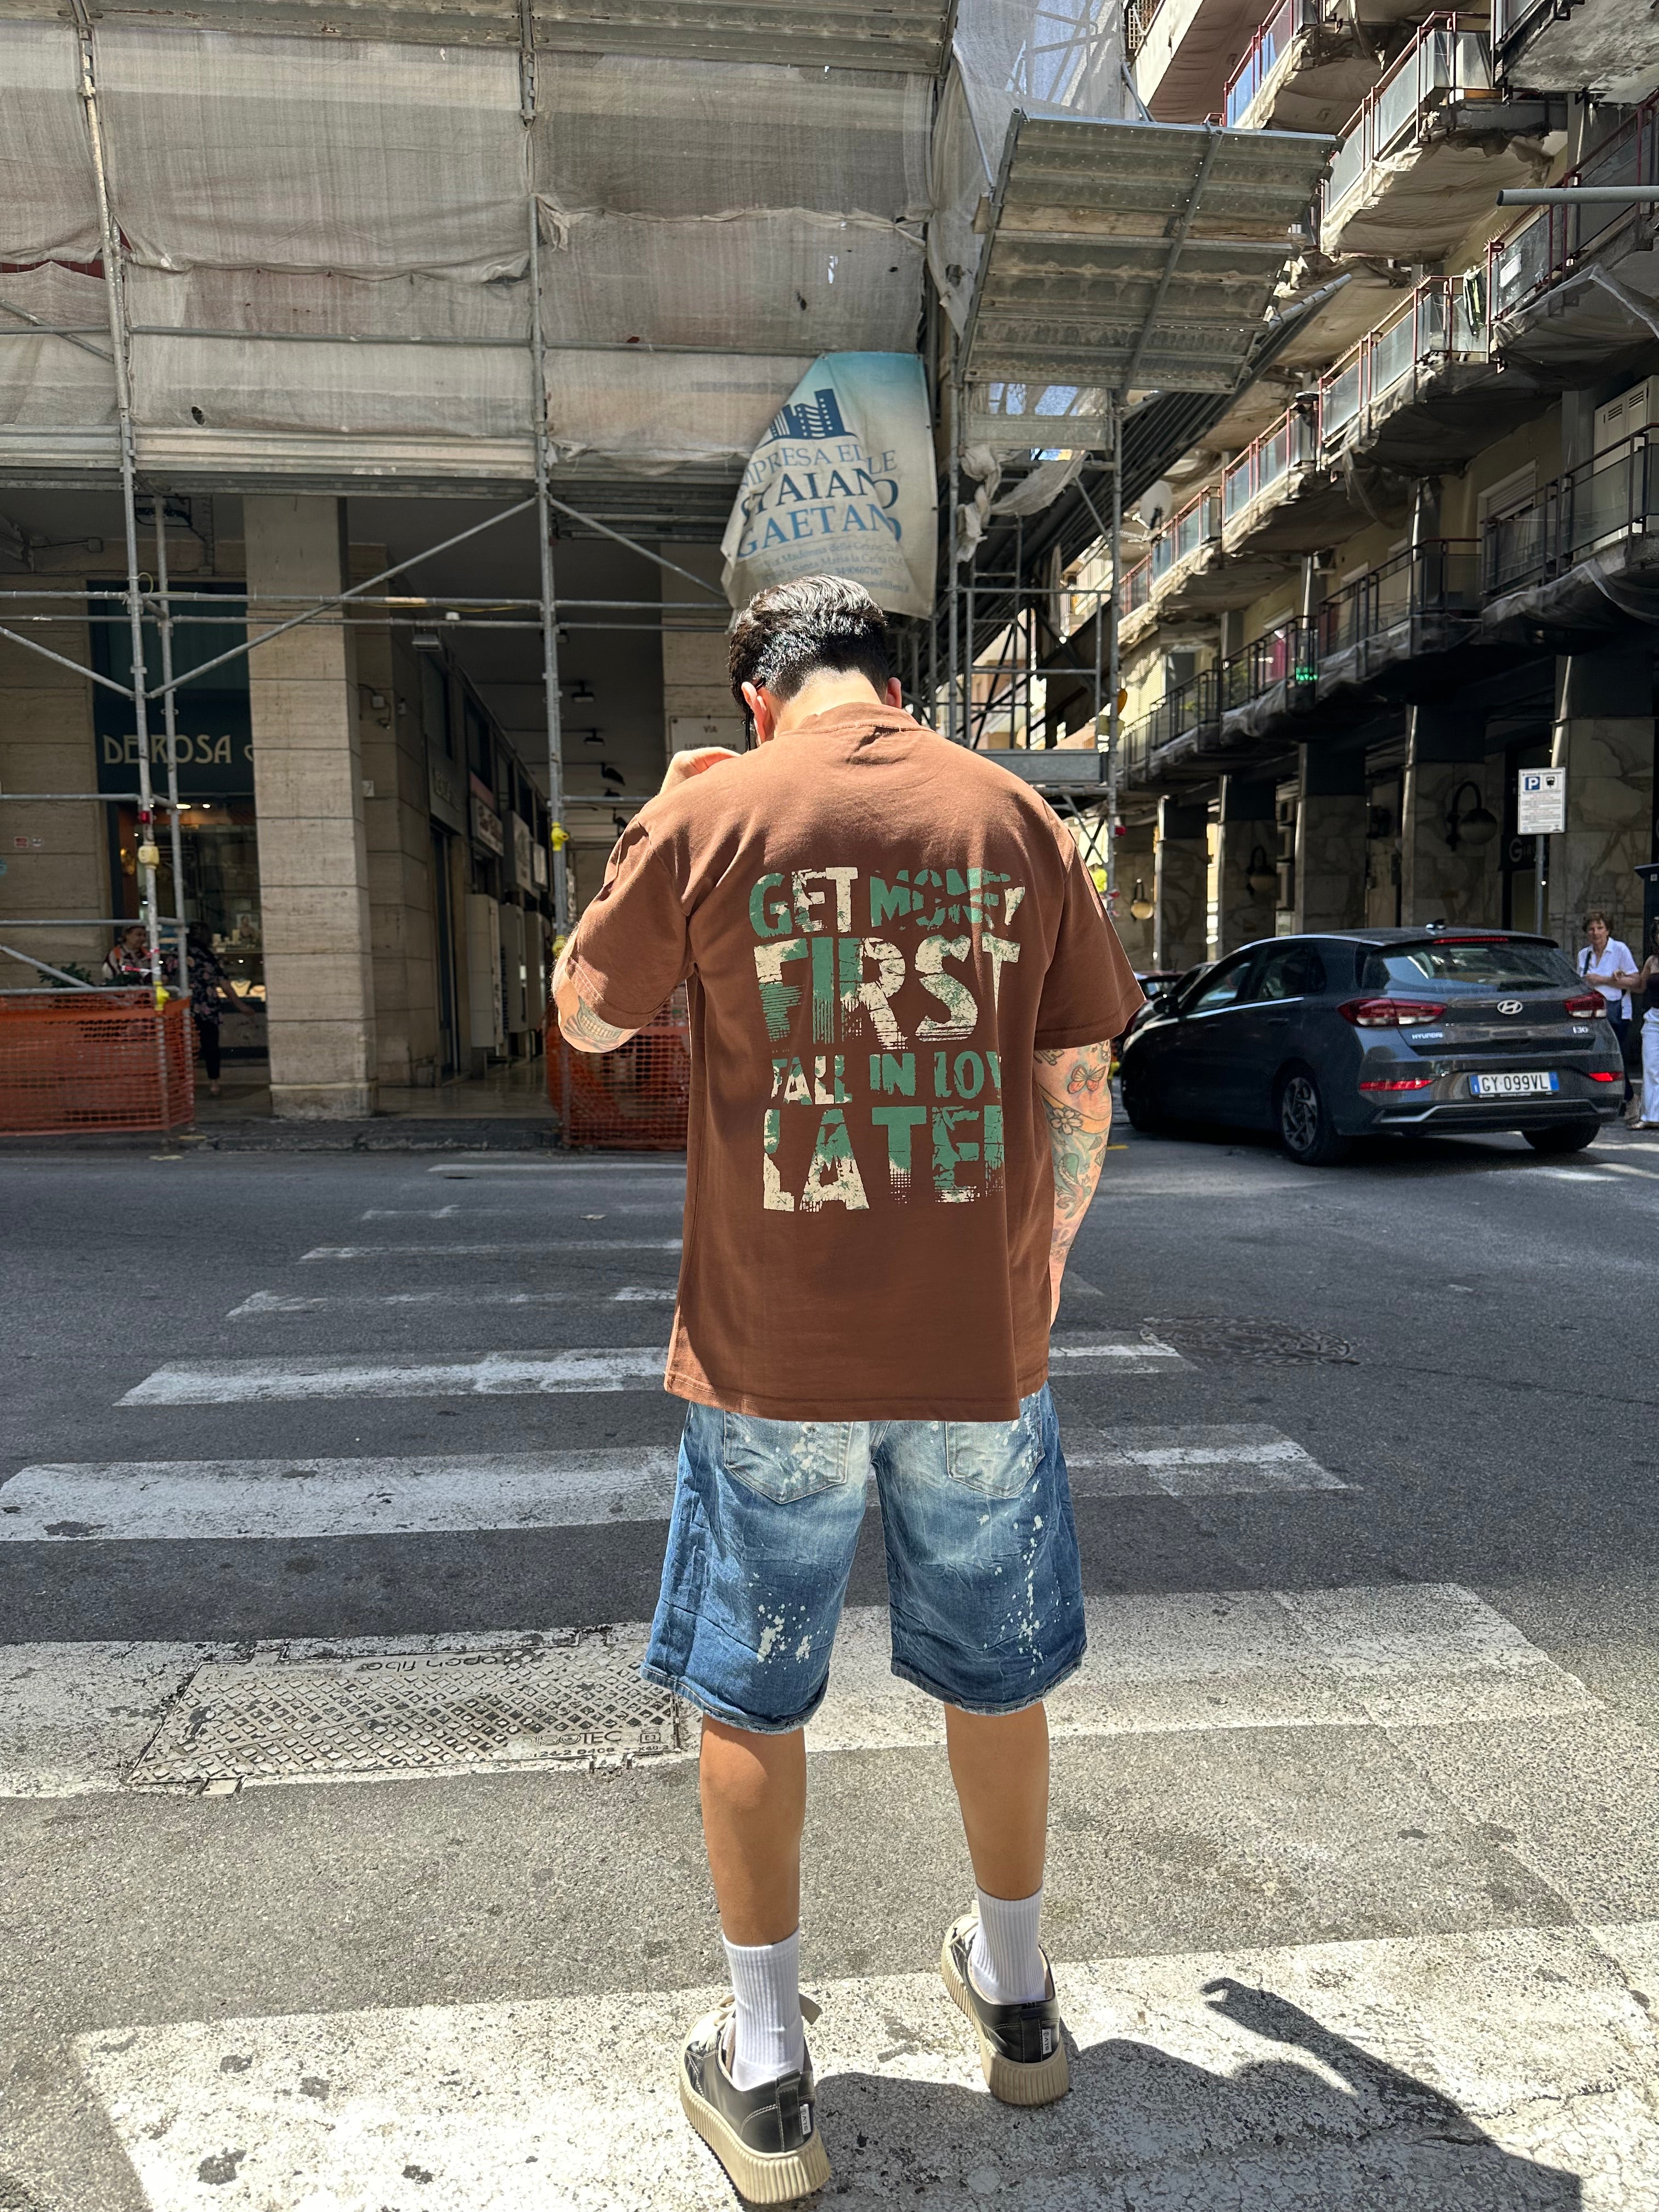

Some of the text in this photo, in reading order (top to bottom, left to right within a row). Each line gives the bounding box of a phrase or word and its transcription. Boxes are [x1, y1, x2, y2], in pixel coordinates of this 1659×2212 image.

[748, 867, 858, 938] GET
[754, 932, 1021, 1049] FIRST
[770, 1054, 853, 1104] FALL
[870, 1052, 917, 1097] IN
[1482, 1076, 1498, 1091] GY
[1503, 1075, 1549, 1091] 099VL
